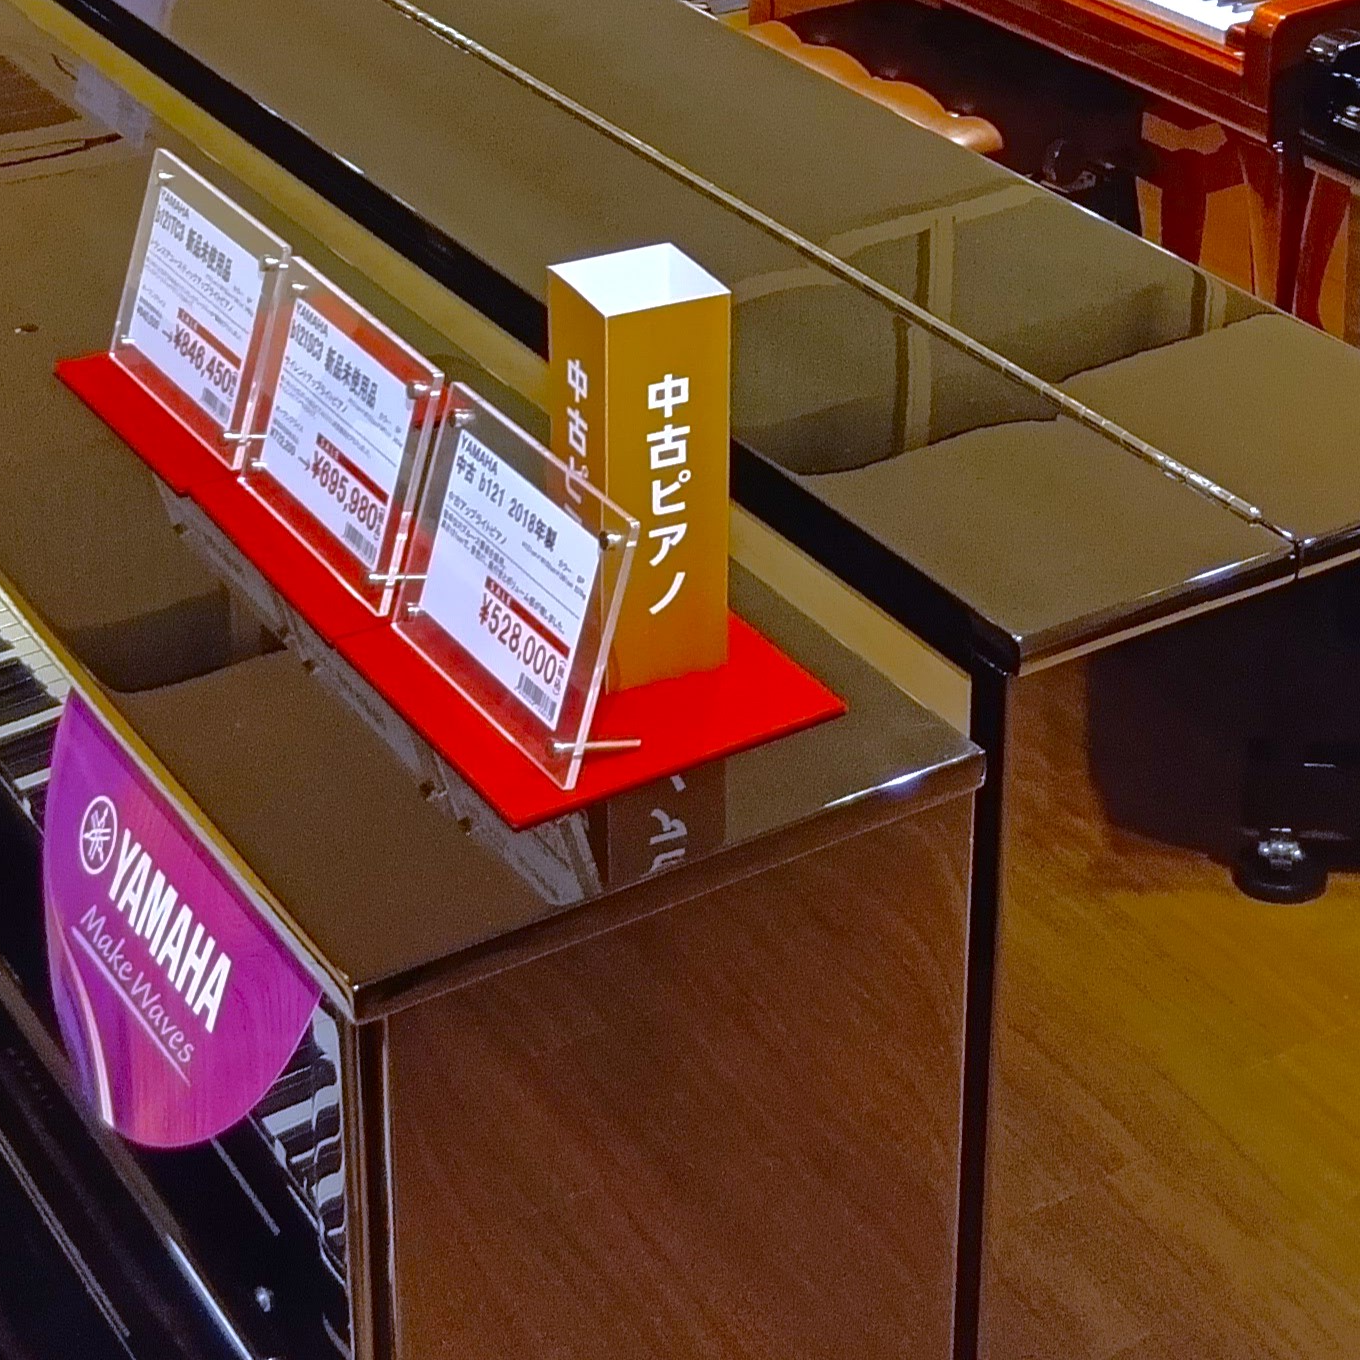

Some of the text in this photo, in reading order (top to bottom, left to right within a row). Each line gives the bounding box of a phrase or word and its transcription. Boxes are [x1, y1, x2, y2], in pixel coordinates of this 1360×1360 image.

[160, 188, 190, 220] YAMAHA
[184, 225, 233, 285] 新品未使用品
[295, 301, 329, 338] YAMAHA
[173, 323, 232, 394] ¥846,450
[289, 317, 379, 410] b121SC3 新品未使用品
[319, 437, 339, 461] SALE
[459, 434, 499, 477] YAMAHA
[311, 450, 378, 531] ¥695,980
[447, 488, 508, 548] 中古アップライトピアノ
[454, 451, 558, 554] 中古 b121 2018年製
[646, 373, 692, 616] 中古ピアノ
[488, 580, 512, 608] SALE
[478, 592, 557, 685] ¥528,000
[108, 828, 232, 1033] YAMAHA
[80, 903, 196, 1065] Make Waves
